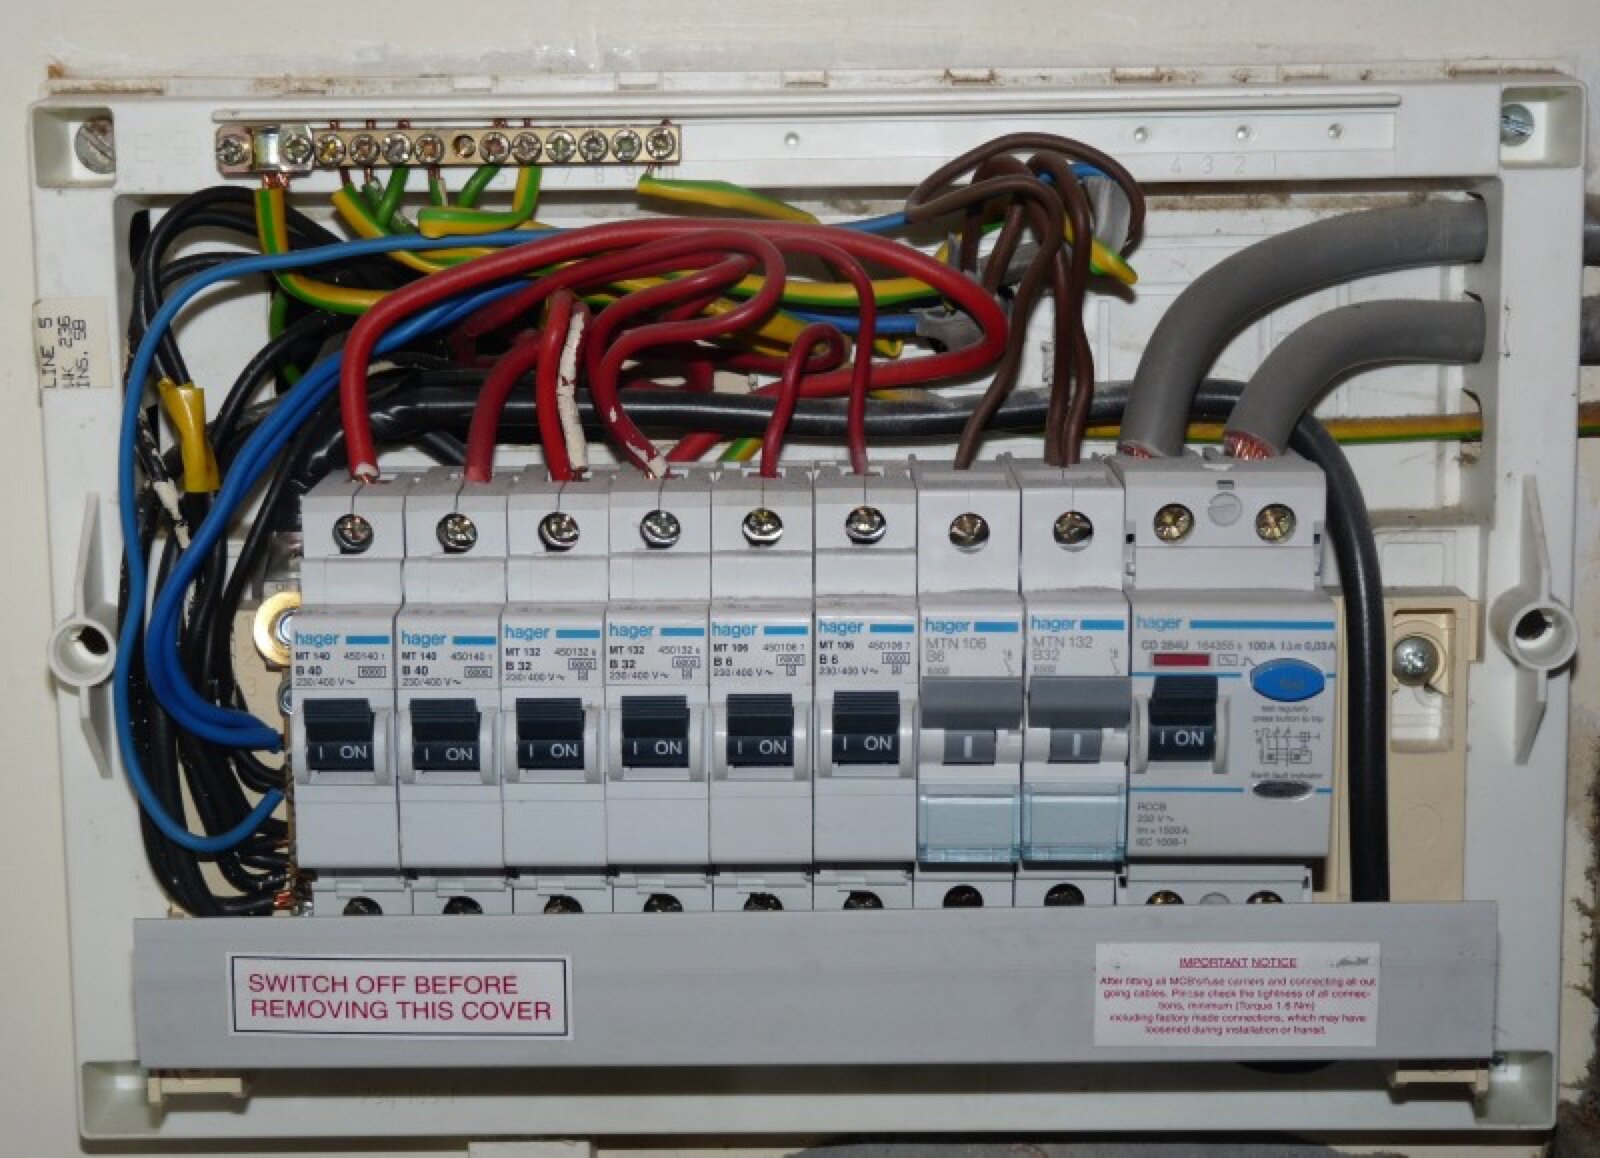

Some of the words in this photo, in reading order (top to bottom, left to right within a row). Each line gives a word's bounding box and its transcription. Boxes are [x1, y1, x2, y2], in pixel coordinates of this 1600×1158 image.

[1203, 156, 1213, 174] 3
[38, 317, 52, 329] 5
[40, 346, 56, 388] LINE
[818, 620, 864, 636] hager
[925, 616, 970, 634] hager
[1032, 614, 1077, 632] hager
[1136, 615, 1182, 632] hager
[505, 624, 550, 642] hager
[610, 622, 654, 638] hager
[712, 622, 758, 638] hager
[294, 631, 340, 648] hager
[402, 630, 446, 648] hager
[820, 641, 834, 649] MT
[927, 637, 959, 649] MTN
[963, 637, 987, 650] 106
[1032, 636, 1064, 648] MTN
[1070, 636, 1093, 648] 132
[1142, 640, 1158, 650] CD
[506, 648, 520, 656] MT
[610, 646, 624, 654] MT
[714, 644, 728, 652] MT
[296, 652, 309, 660] MT
[402, 652, 416, 660] MT
[820, 654, 828, 664] B
[832, 655, 838, 664] 6
[1032, 649, 1059, 661] B32
[506, 662, 514, 670] B
[518, 662, 532, 670] 32
[610, 660, 618, 668] B
[622, 660, 636, 668] 32
[714, 657, 722, 666] B
[726, 657, 732, 666] 6
[296, 666, 304, 675] B
[308, 666, 322, 675] 40
[402, 666, 410, 674] B
[414, 666, 428, 675] 40
[863, 736, 892, 751] ON
[1175, 730, 1204, 745] ON
[340, 745, 367, 759] ON
[551, 743, 577, 757] ON
[655, 741, 683, 755] ON
[759, 739, 787, 755] ON
[446, 748, 473, 761] ON
[1136, 838, 1152, 846] IEC
[1180, 957, 1248, 968] IMPORTANT
[1251, 957, 1296, 968] NOTICE
[249, 973, 347, 993] SWITCH
[356, 975, 406, 994] OFF
[415, 976, 518, 995] BEFORE
[1100, 977, 1122, 985] After
[1126, 977, 1152, 987] fitting
[1156, 977, 1166, 985] all
[1228, 978, 1264, 986] carriers
[1268, 978, 1286, 986] and
[1290, 977, 1344, 988] connecting
[1346, 977, 1357, 986] all
[1360, 978, 1376, 986] out
[1104, 990, 1130, 999] going
[1208, 990, 1236, 998] check
[1240, 990, 1254, 998] the
[1258, 990, 1302, 1000] tightness
[1306, 990, 1315, 998] of
[1318, 990, 1328, 998] all
[1332, 990, 1371, 998] connec-
[251, 999, 388, 1019] REMOVING
[396, 1001, 453, 1020] THIS
[462, 1001, 551, 1021] COVER
[1110, 1014, 1152, 1023] including
[1156, 1014, 1189, 1023] factory
[1192, 1014, 1219, 1022] made
[1288, 1014, 1316, 1022] which
[1320, 1015, 1340, 1024] may
[1342, 1014, 1366, 1022] have
[1146, 1026, 1190, 1034] loosened
[1192, 1026, 1222, 1036] during
[1226, 1026, 1278, 1034] installation
